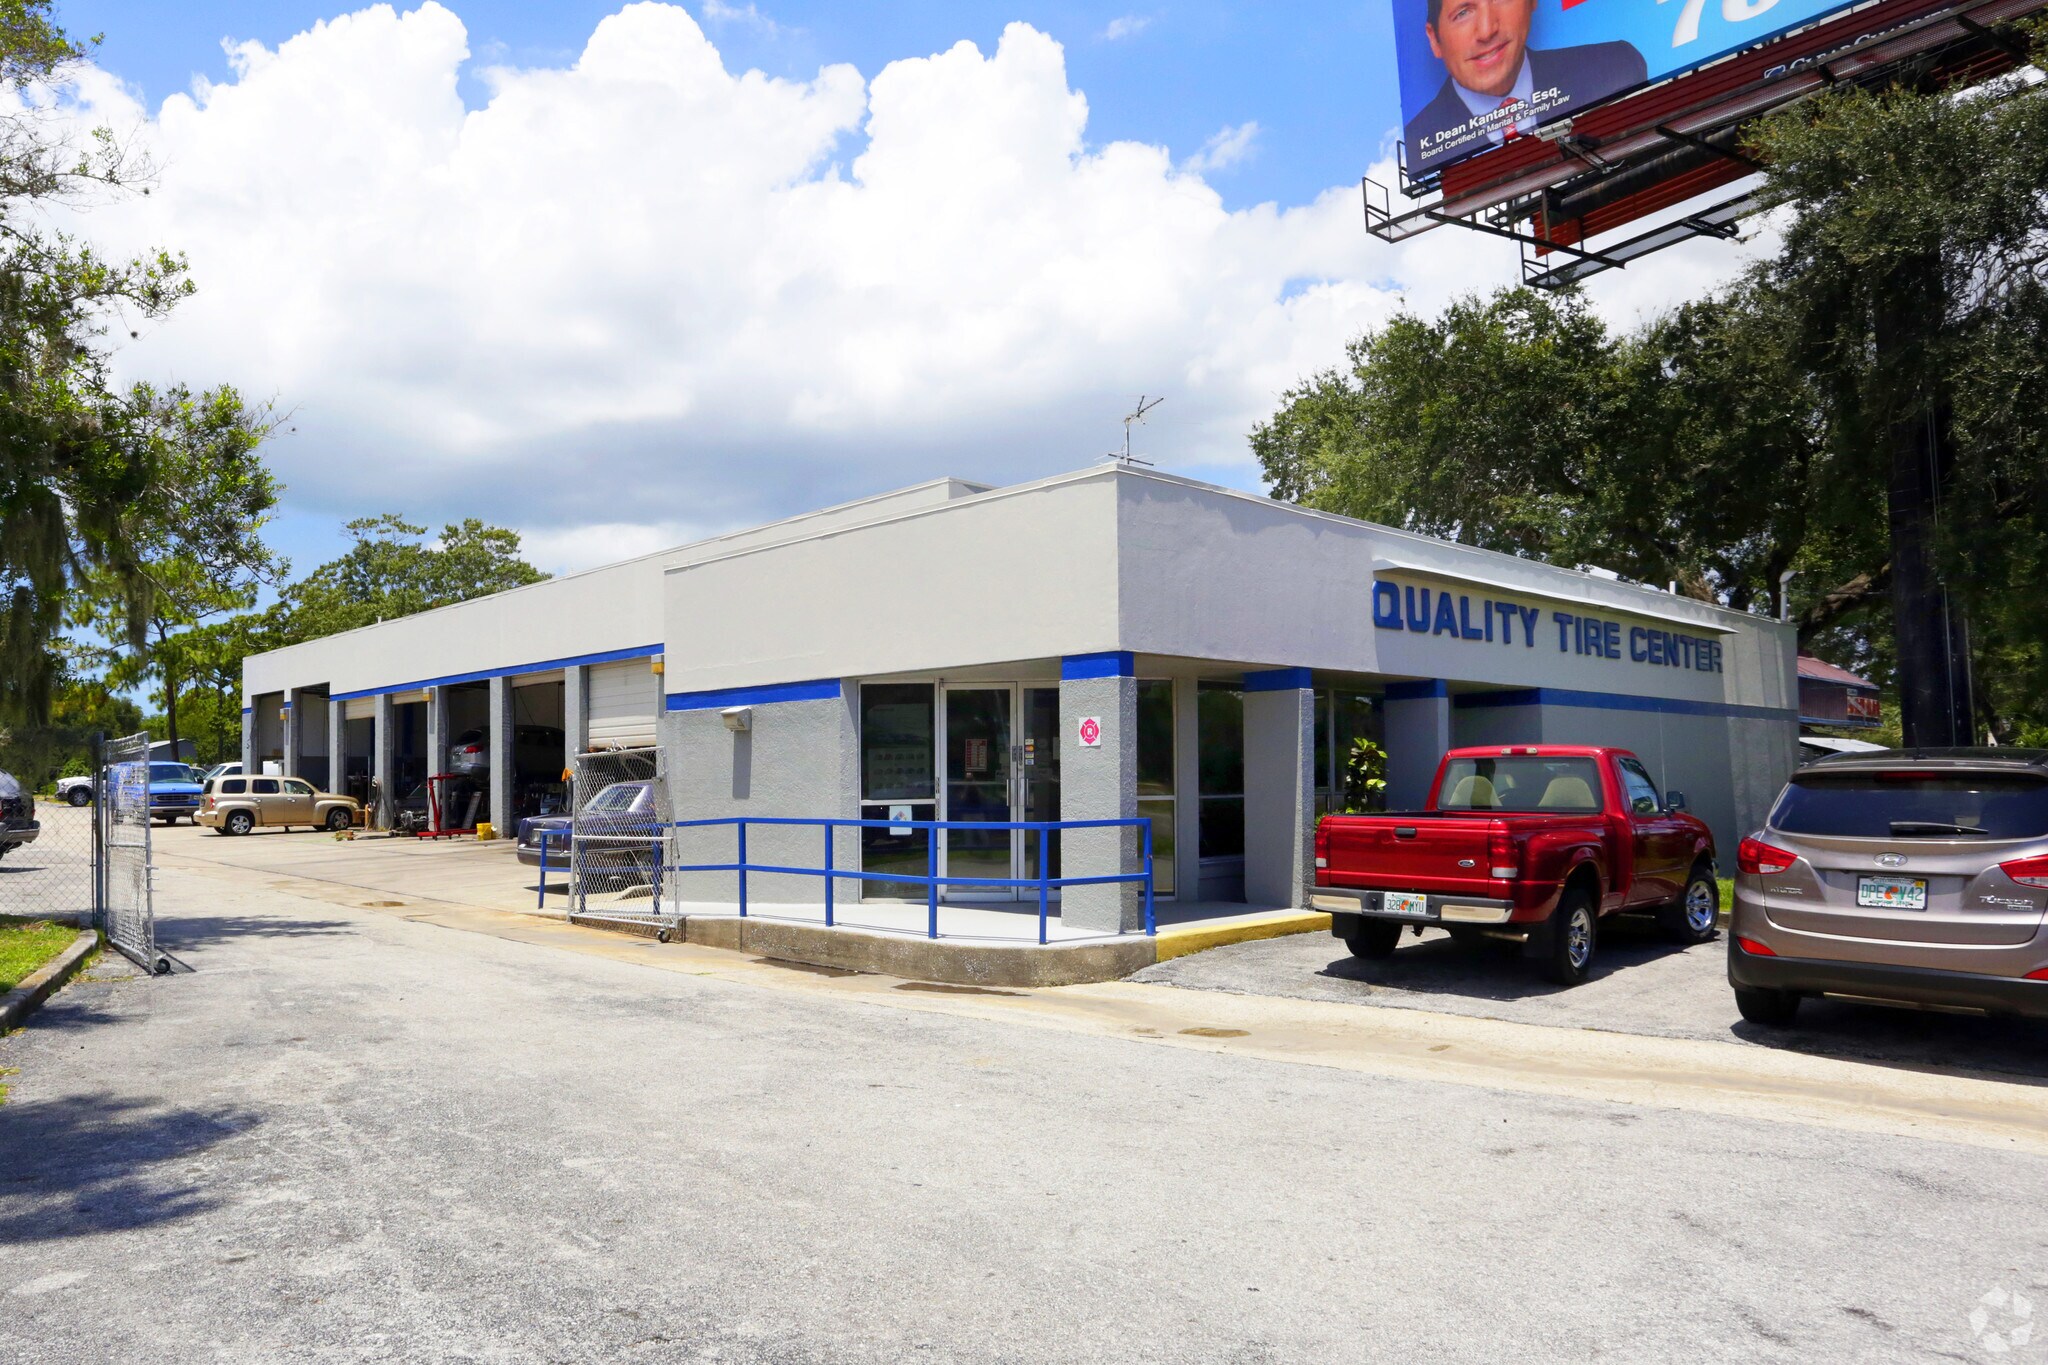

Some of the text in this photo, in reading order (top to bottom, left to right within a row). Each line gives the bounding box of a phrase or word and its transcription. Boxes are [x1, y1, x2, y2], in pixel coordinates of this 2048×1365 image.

[1419, 86, 1561, 150] K. Dean Kantaras, Esq.
[1420, 94, 1570, 160] Board Certified in Marital & Family Law
[1372, 580, 1723, 674] QUALITY TIRE CENTER
